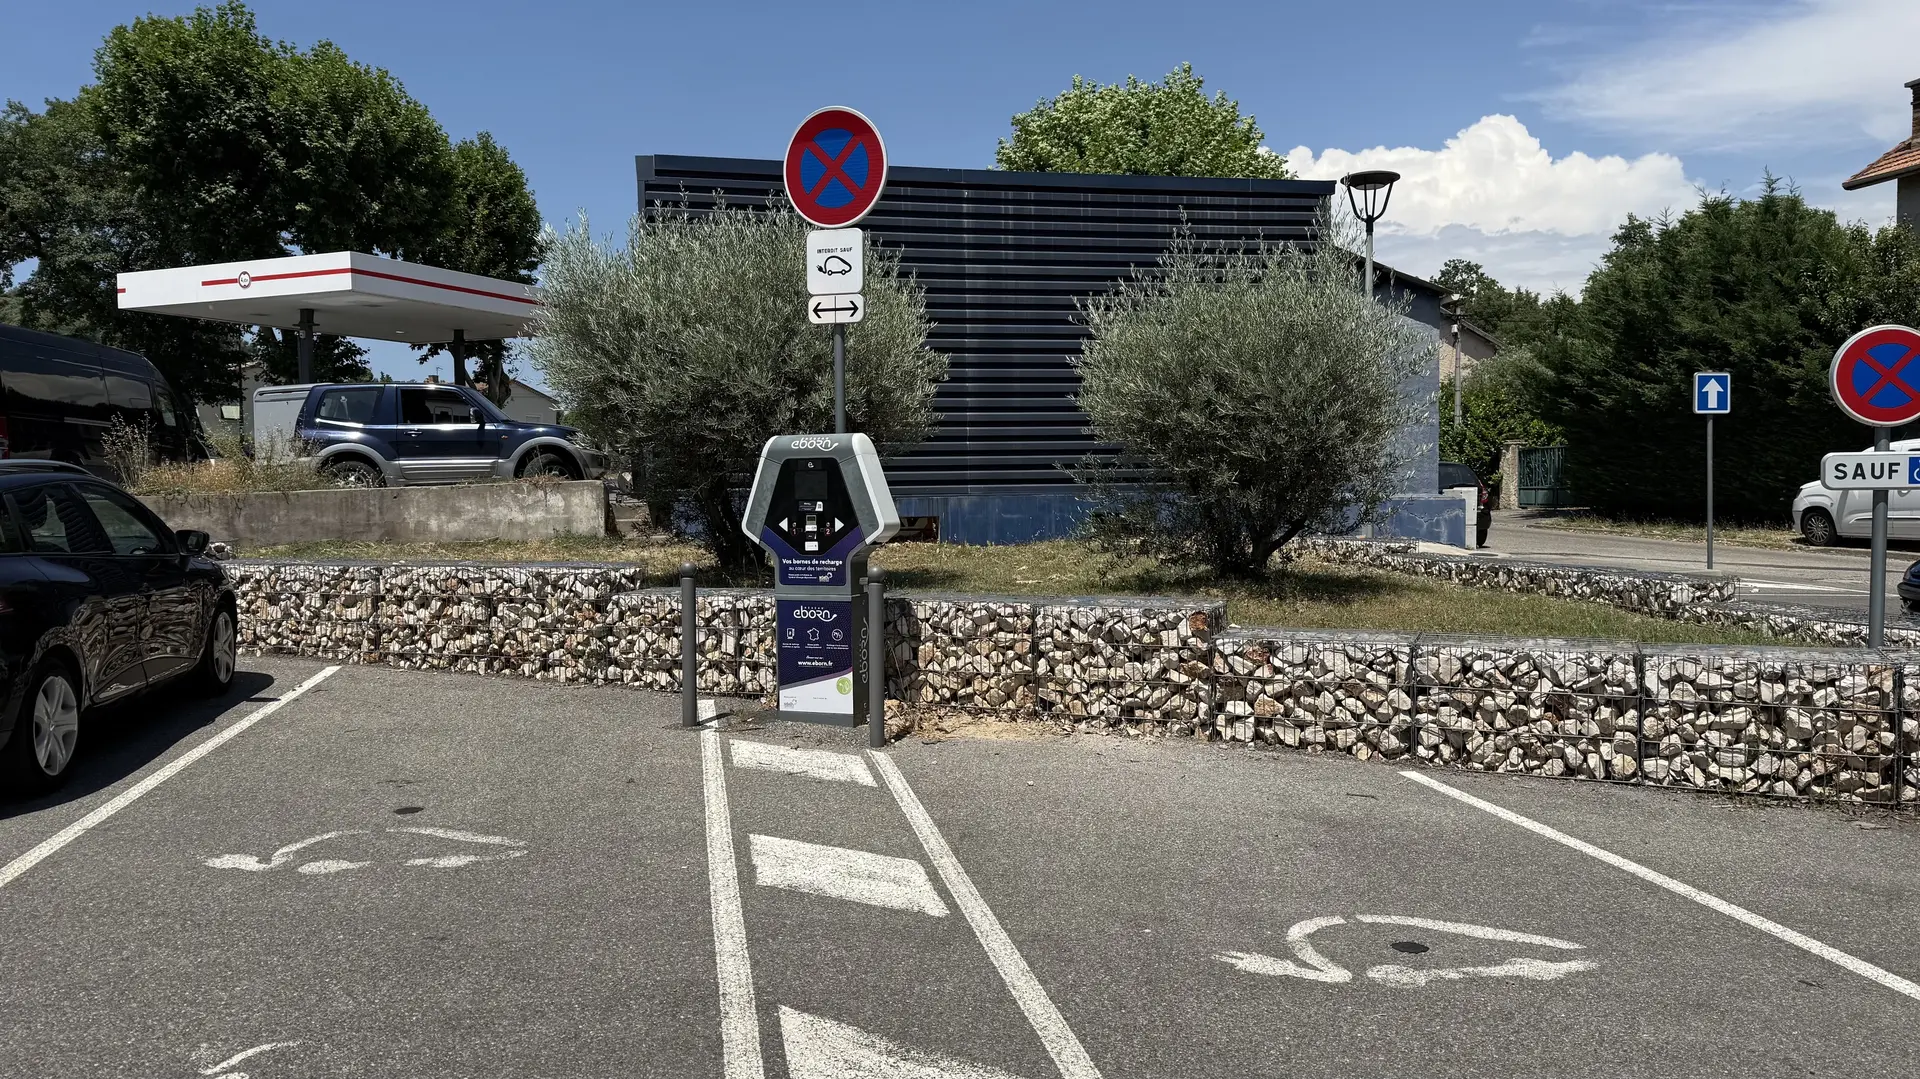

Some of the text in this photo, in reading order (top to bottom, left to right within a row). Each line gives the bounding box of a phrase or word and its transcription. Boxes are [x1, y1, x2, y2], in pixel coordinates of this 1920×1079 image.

[791, 437, 839, 452] eborn
[1833, 462, 1901, 480] SAUF
[820, 558, 843, 566] recharge
[793, 605, 838, 622] eborn
[797, 660, 833, 668] www.eborn.fr
